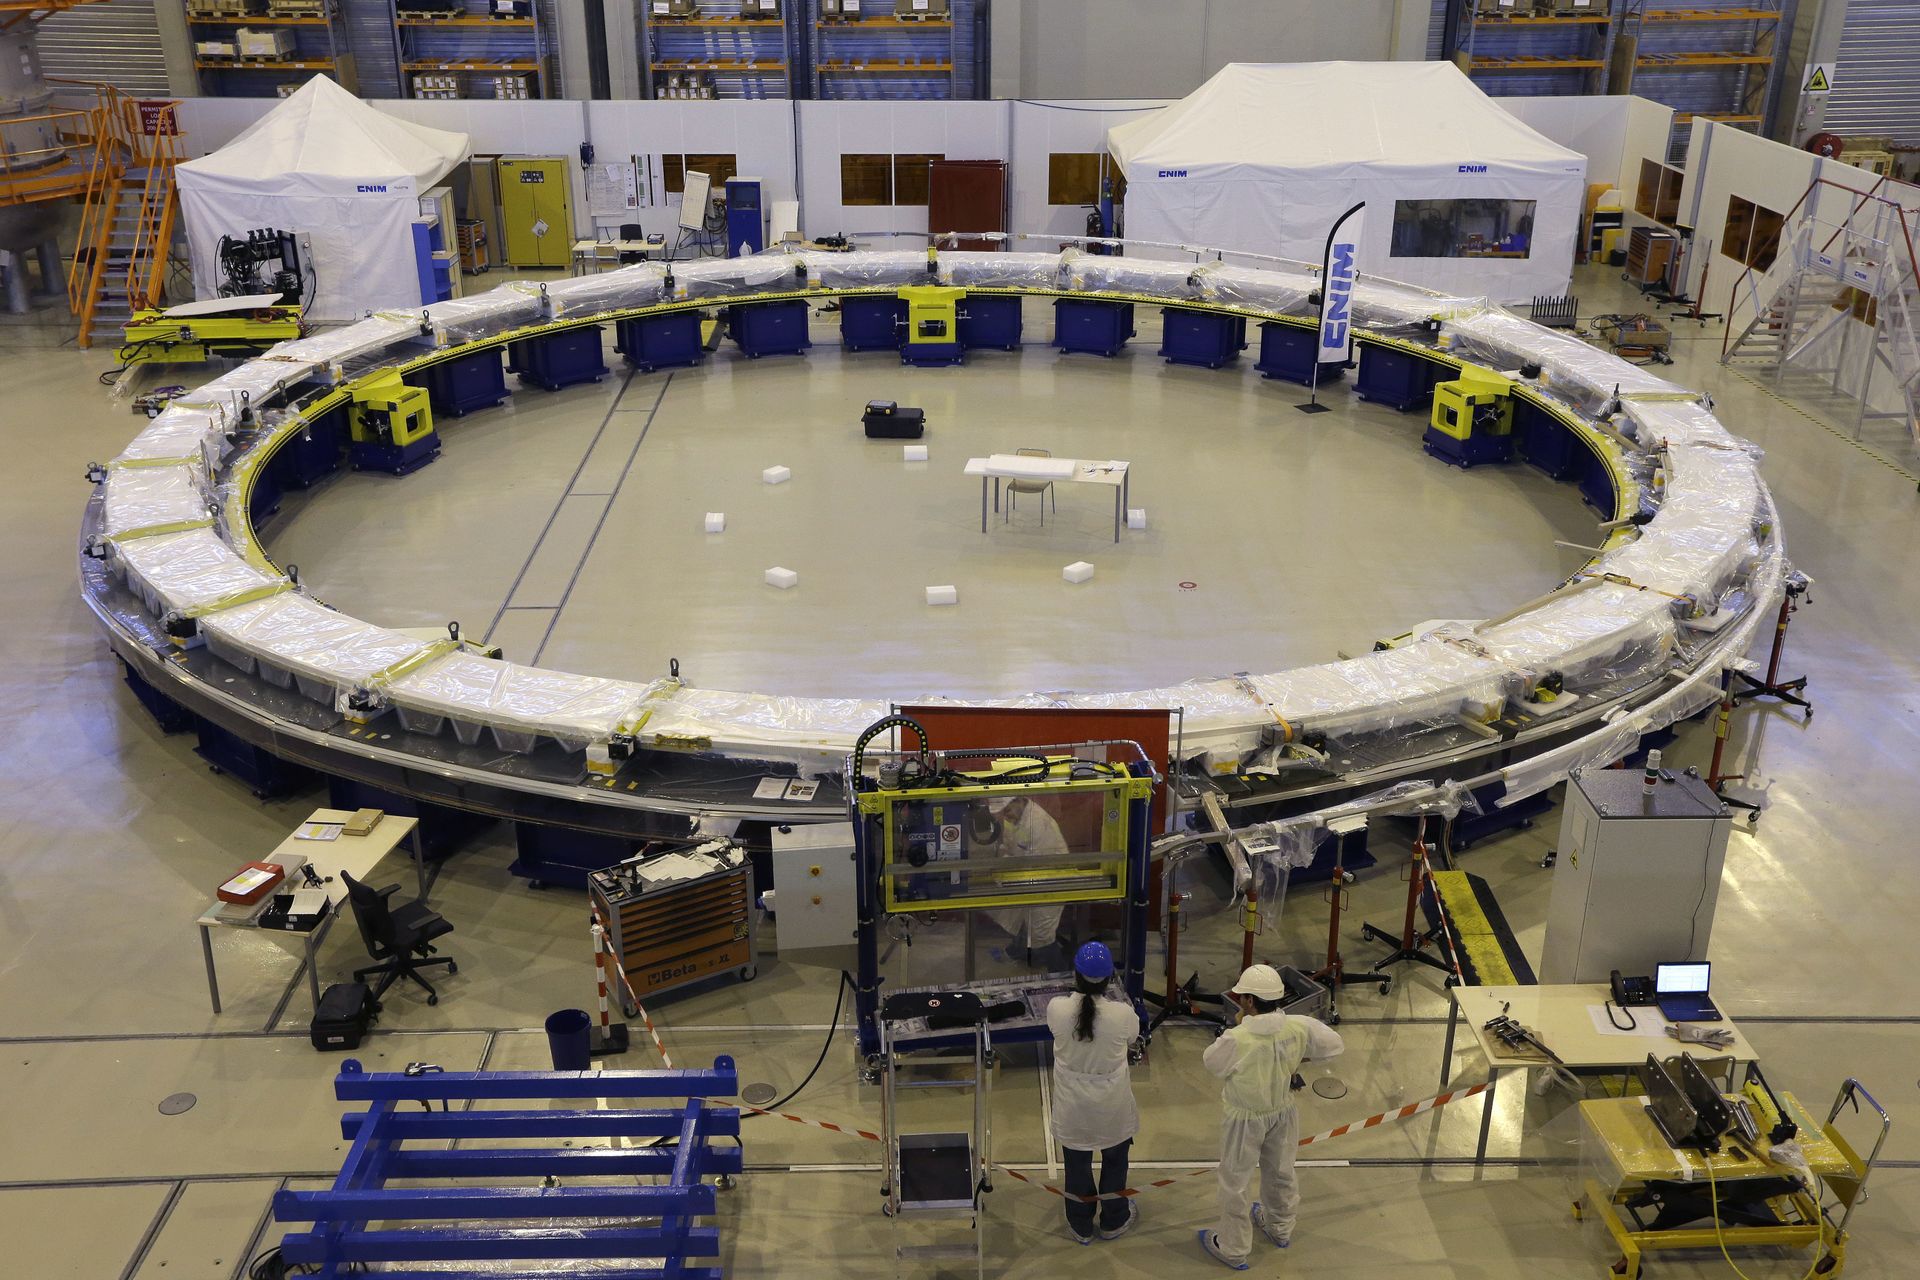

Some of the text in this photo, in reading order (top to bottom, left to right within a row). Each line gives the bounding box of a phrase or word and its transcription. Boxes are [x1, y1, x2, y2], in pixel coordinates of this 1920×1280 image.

[1458, 165, 1487, 173] CNIM
[1158, 170, 1187, 178] CNIM
[356, 185, 387, 193] CNIM
[1322, 243, 1355, 349] CNIM
[661, 962, 697, 981] Beta
